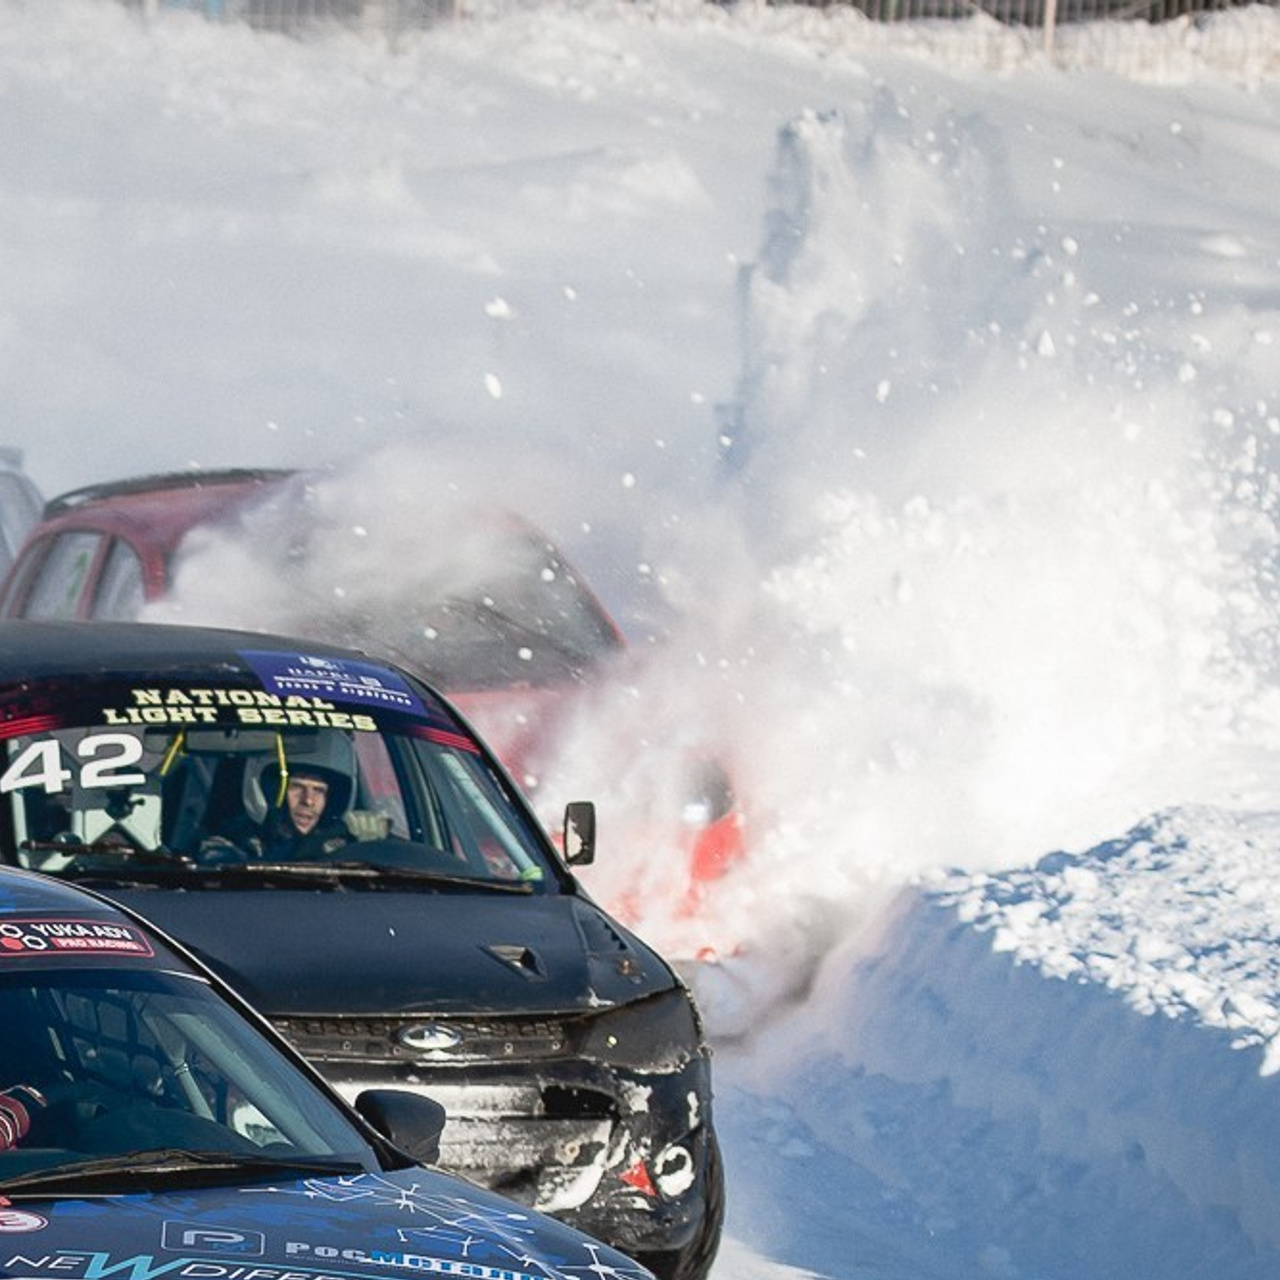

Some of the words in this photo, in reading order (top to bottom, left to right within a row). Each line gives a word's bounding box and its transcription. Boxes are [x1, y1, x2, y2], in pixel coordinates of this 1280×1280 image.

[132, 688, 335, 710] NATIONAL
[102, 706, 219, 725] LIGHT
[236, 709, 378, 732] SERIES
[0, 733, 146, 794] 42
[31, 924, 96, 938] YUKA
